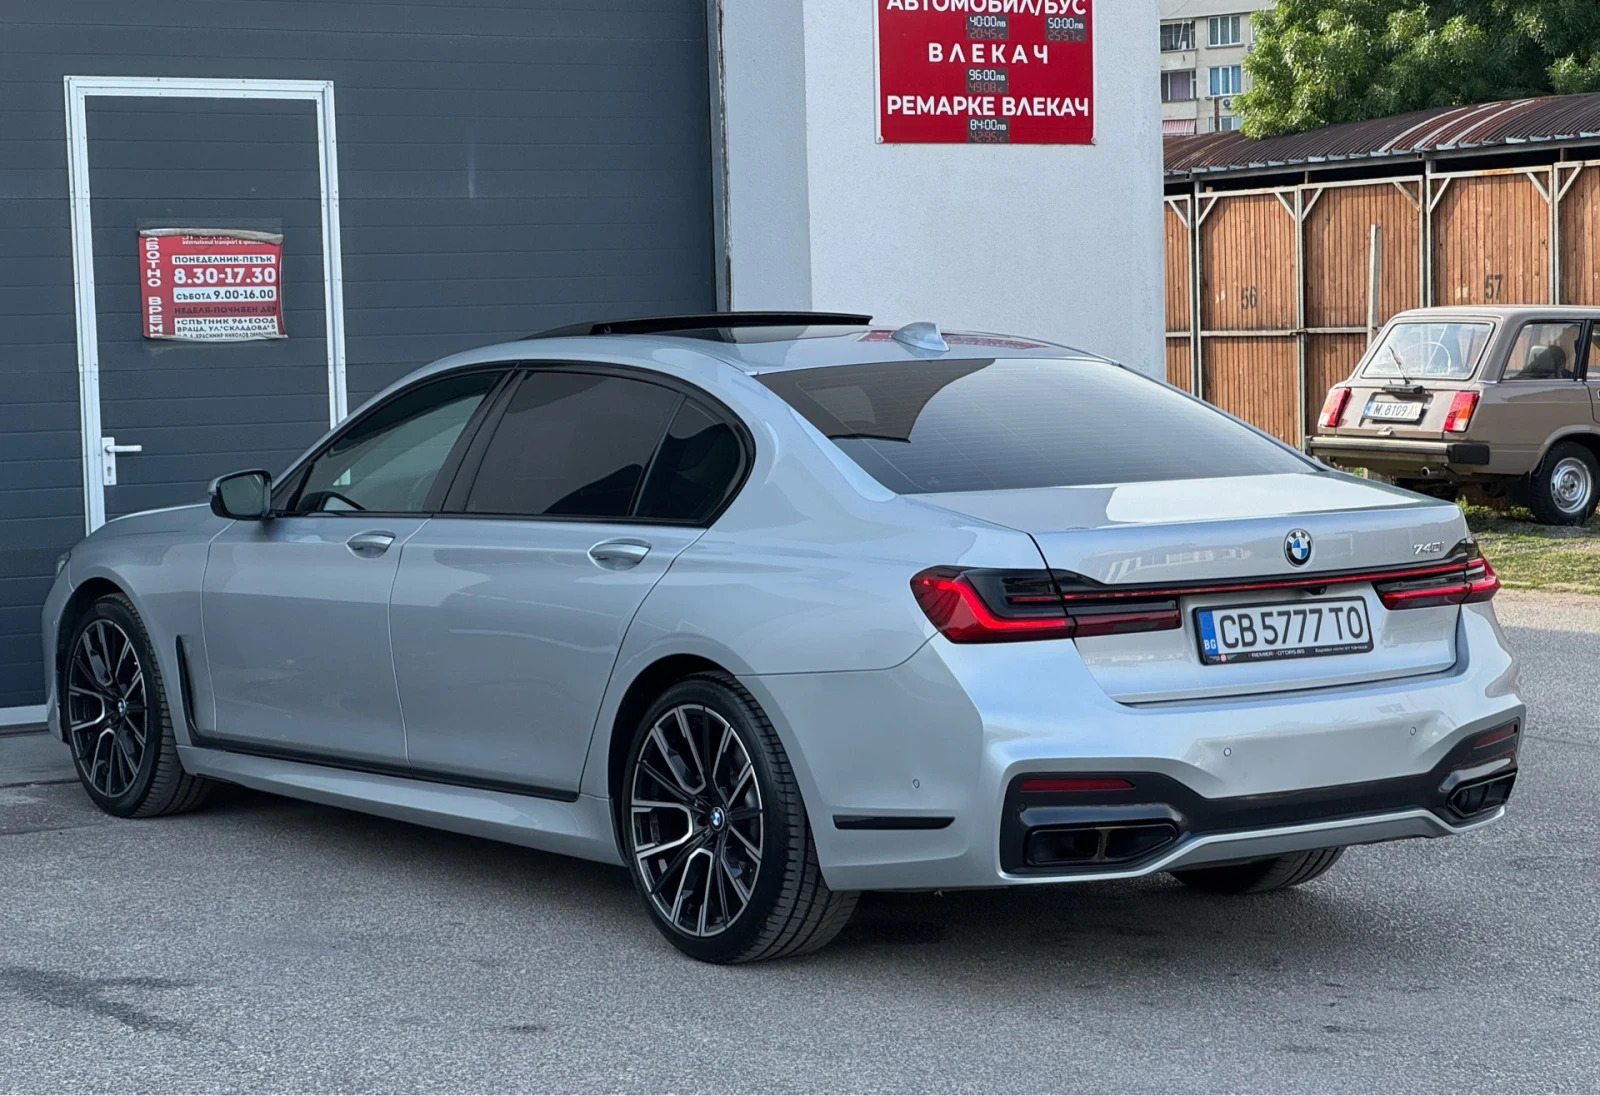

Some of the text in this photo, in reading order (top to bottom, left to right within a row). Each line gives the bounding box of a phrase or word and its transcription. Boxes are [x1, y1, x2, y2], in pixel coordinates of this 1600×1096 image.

[928, 42, 1048, 64] ВЛЕКАЧ
[887, 95, 1089, 117] РЕМАРКЕ ВЛЕКАЧ
[174, 267, 276, 284] 8.30-17.30
[176, 289, 274, 301] СЪБОТА 9.00-16.00
[1240, 286, 1257, 310] 56
[1485, 274, 1503, 300] 57
[148, 296, 163, 336] ВРЕМ
[1219, 606, 1364, 649] CB 5777 TO
[1203, 639, 1217, 650] BG
